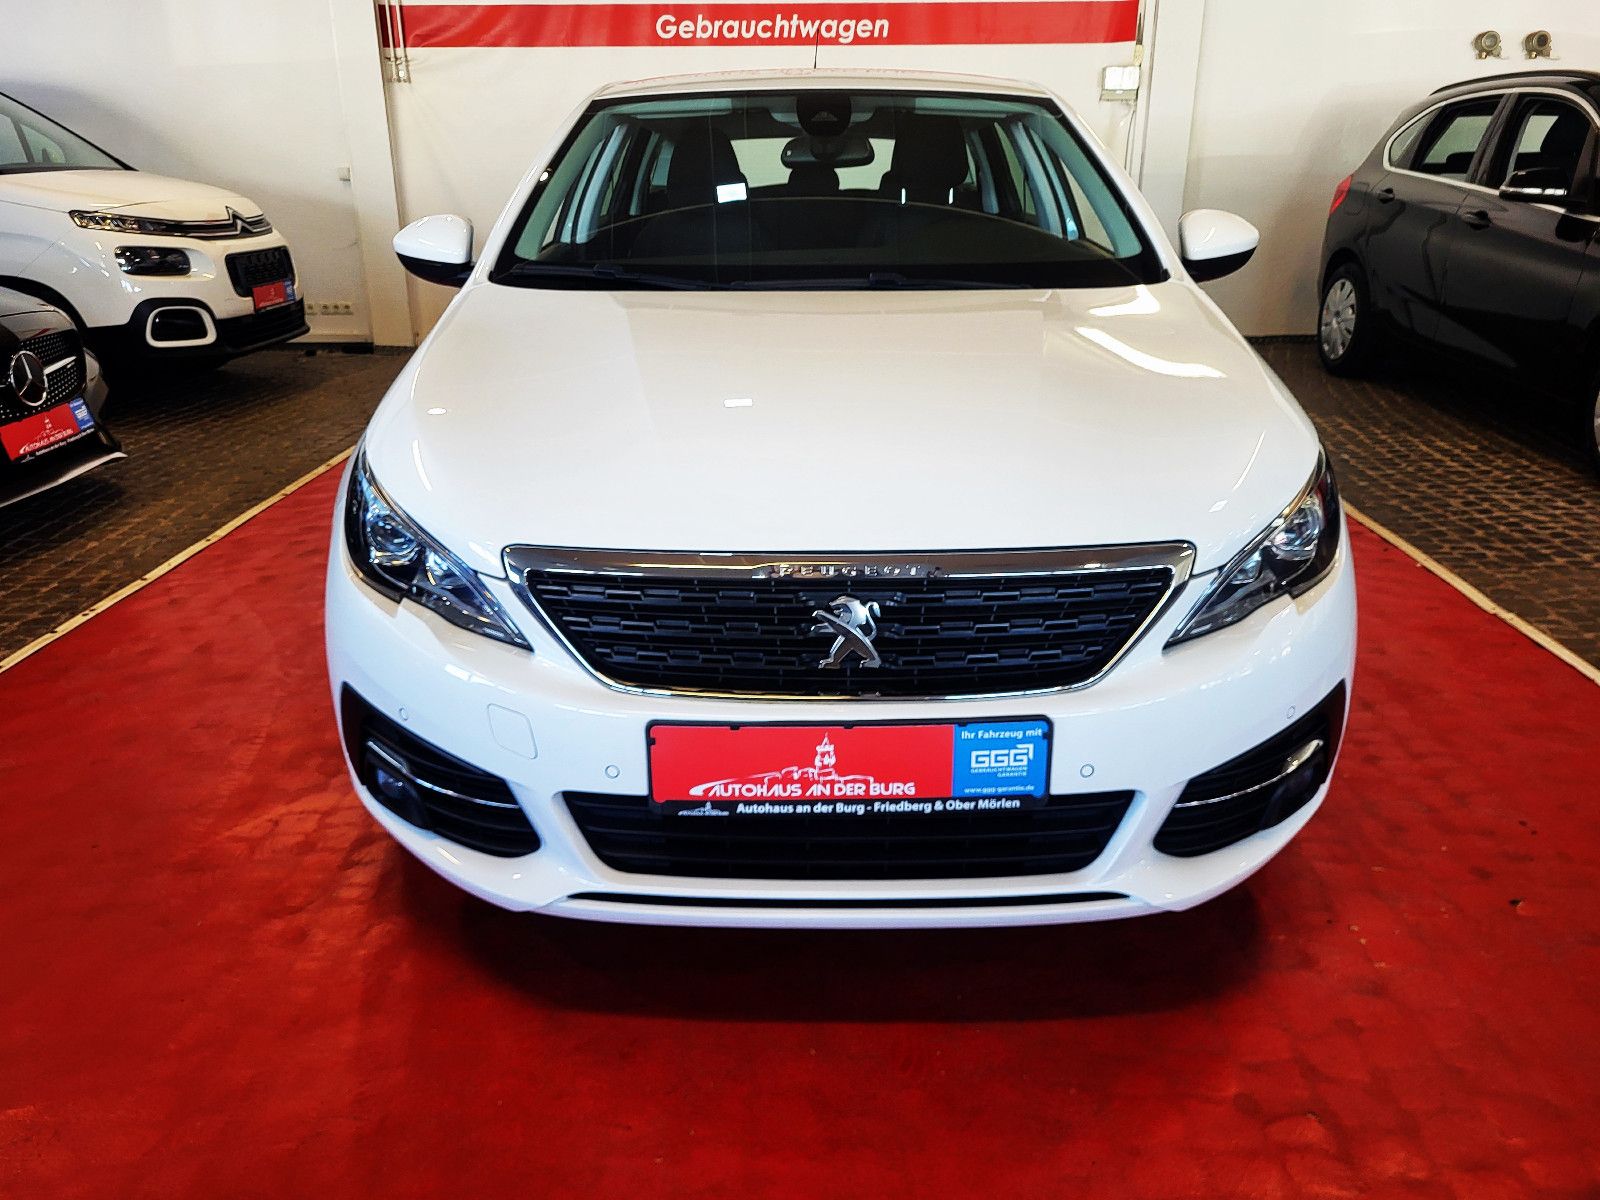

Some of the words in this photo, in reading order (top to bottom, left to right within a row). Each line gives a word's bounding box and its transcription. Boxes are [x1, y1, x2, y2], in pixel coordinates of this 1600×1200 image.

[656, 13, 889, 44] Gebrauchtwagen
[779, 564, 921, 577] PEUGEOT
[961, 730, 976, 740] Ihr
[978, 729, 1023, 739] Fahrzeug
[1025, 727, 1042, 737] mit
[971, 748, 1029, 768] GGG
[708, 783, 802, 797] AUTOHAUS
[805, 783, 831, 797] AN
[834, 782, 866, 796] DER
[870, 781, 916, 796] BURG
[736, 802, 794, 814] Autohaus
[795, 804, 811, 814] an
[813, 802, 834, 814] der
[836, 802, 865, 816] Burg
[874, 800, 933, 814] Friedberg
[934, 800, 944, 811] &
[946, 799, 976, 811] Ober
[978, 797, 1021, 810] Mörlen
